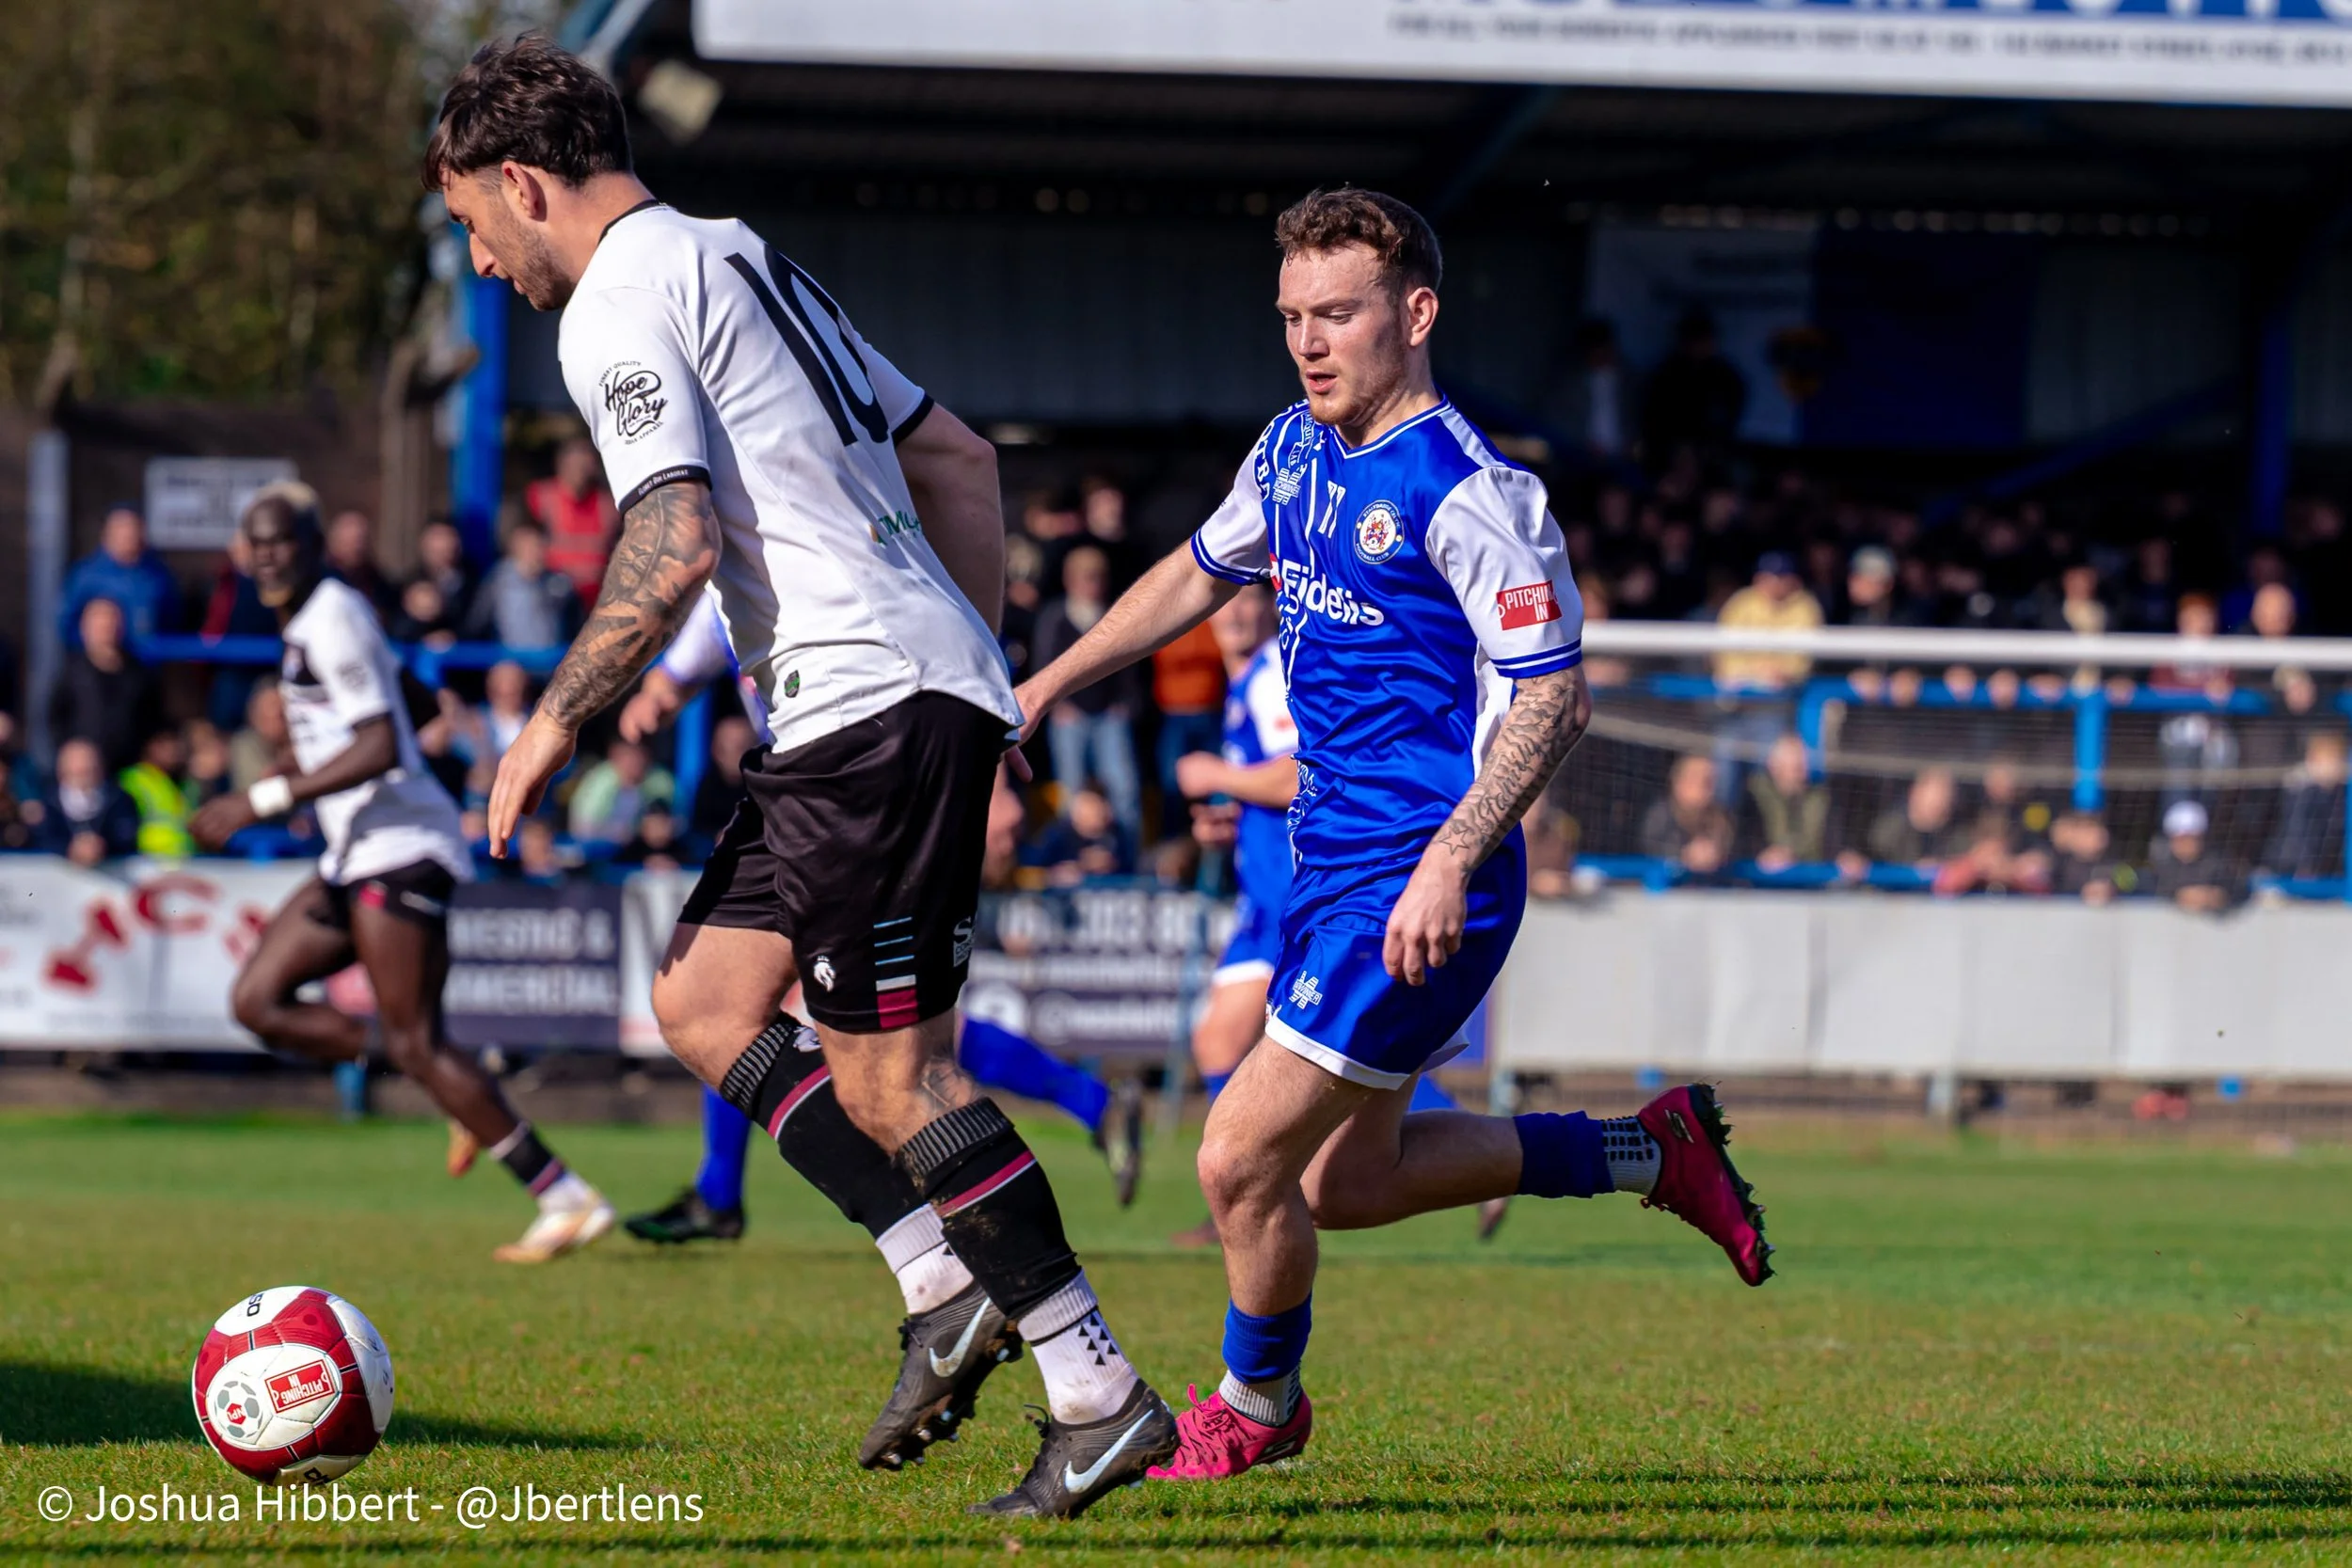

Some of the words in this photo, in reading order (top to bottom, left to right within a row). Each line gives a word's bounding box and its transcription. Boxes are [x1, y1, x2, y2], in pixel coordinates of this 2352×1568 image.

[723, 243, 889, 448] 10
[613, 360, 642, 370] QUALITY
[605, 371, 661, 412] Hope
[616, 398, 669, 436] Glory
[1375, 551, 1390, 562] CLUB
[1281, 559, 1385, 626] Fidelis
[280, 1380, 325, 1403] PITCHING
[289, 1373, 301, 1388] IN
[226, 1408, 246, 1421] NPL
